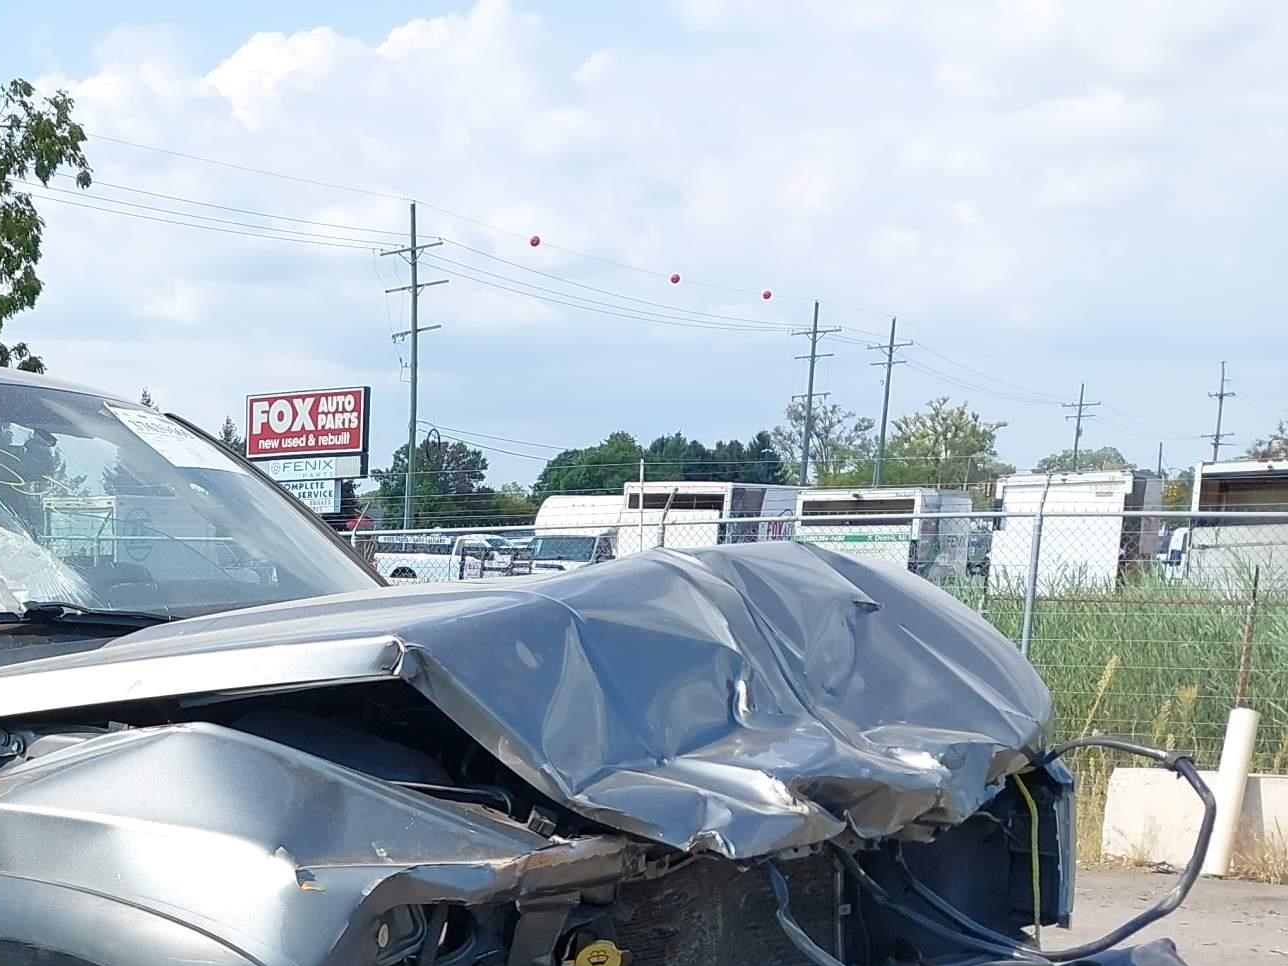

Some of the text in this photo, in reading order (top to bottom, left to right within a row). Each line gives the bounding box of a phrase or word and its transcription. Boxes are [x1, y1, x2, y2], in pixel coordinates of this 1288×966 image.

[252, 394, 355, 435] FOX AUTO
[317, 412, 359, 430] PARTS
[258, 431, 351, 450] new used & rebuilt
[282, 459, 334, 472] FENIX
[297, 490, 333, 499] SERVICE
